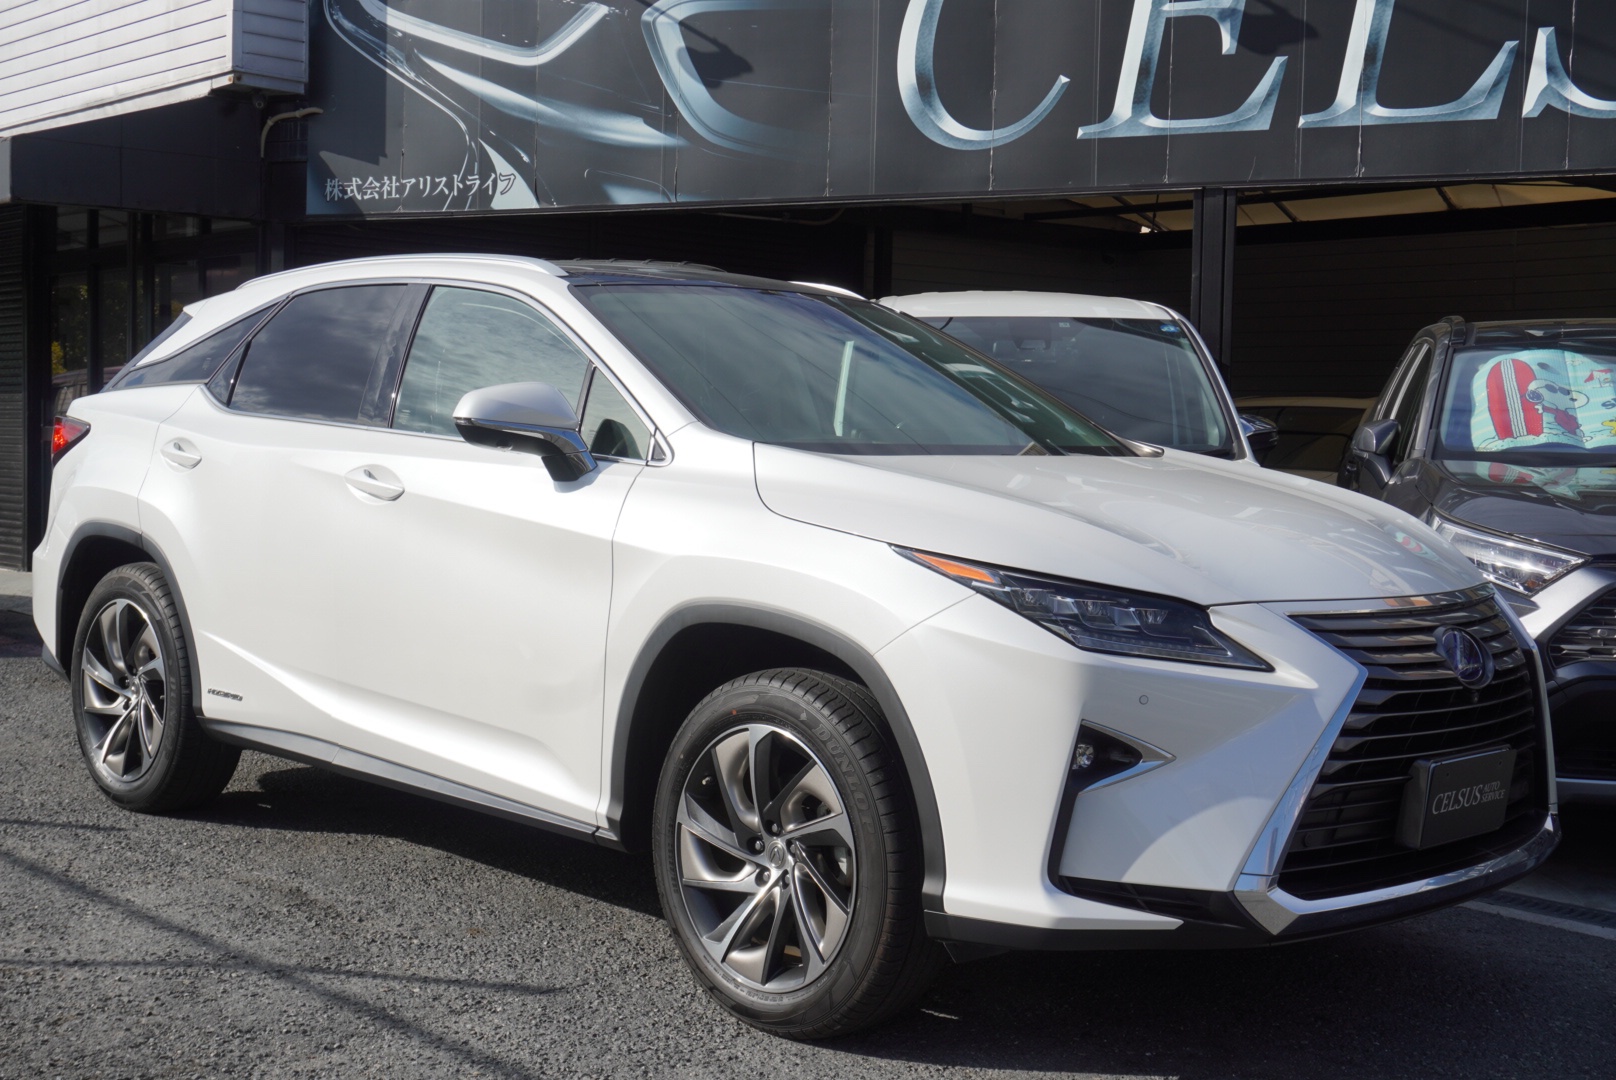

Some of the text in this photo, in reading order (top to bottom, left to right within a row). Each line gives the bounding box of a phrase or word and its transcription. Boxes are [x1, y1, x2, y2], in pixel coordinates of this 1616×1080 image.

[896, 0, 1616, 151] CEL
[324, 173, 517, 201] 株式会社アリストライフ
[811, 723, 876, 834] DUNLOP
[1483, 780, 1501, 793] AUTO
[1432, 784, 1483, 815] CELSUS
[1482, 789, 1505, 803] SERVICE
